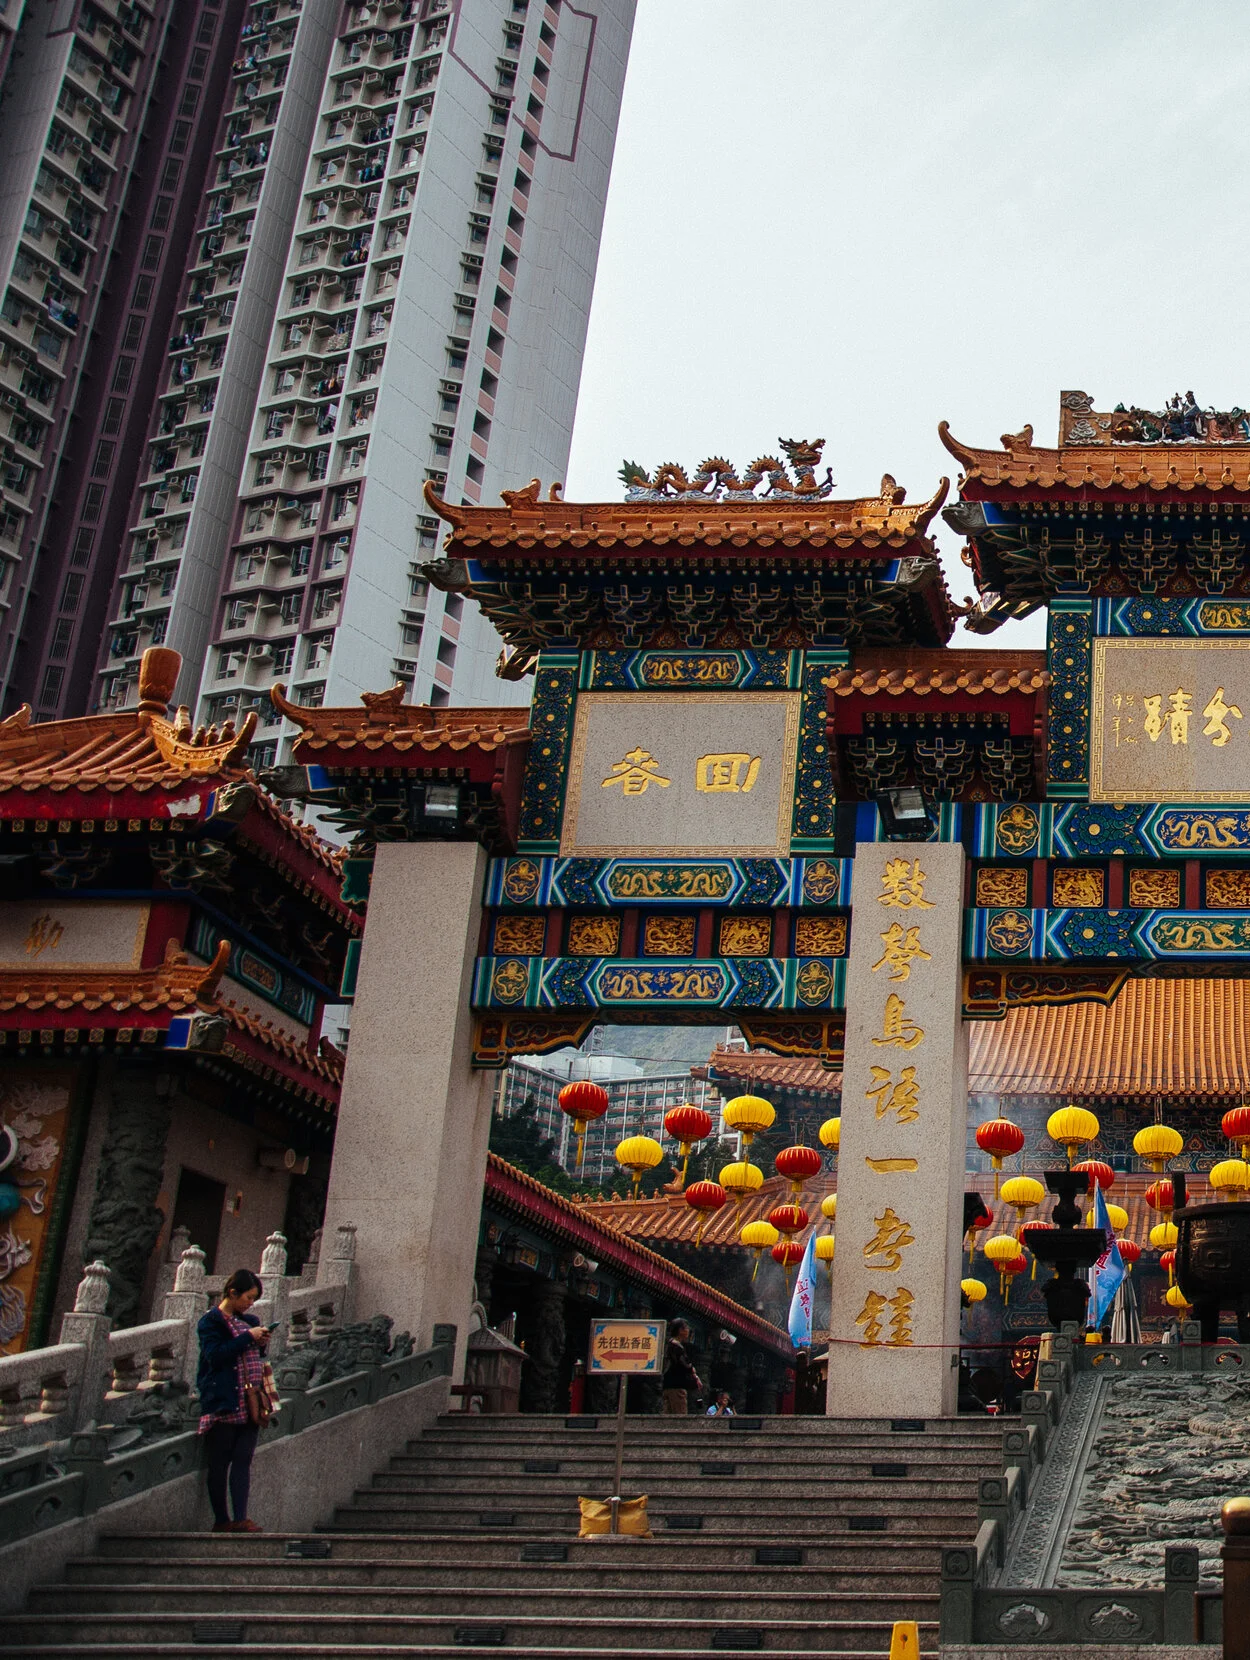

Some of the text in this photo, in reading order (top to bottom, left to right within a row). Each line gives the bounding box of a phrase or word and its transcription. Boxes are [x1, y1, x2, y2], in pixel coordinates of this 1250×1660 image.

[598, 1336, 652, 1350] 先往點香區
